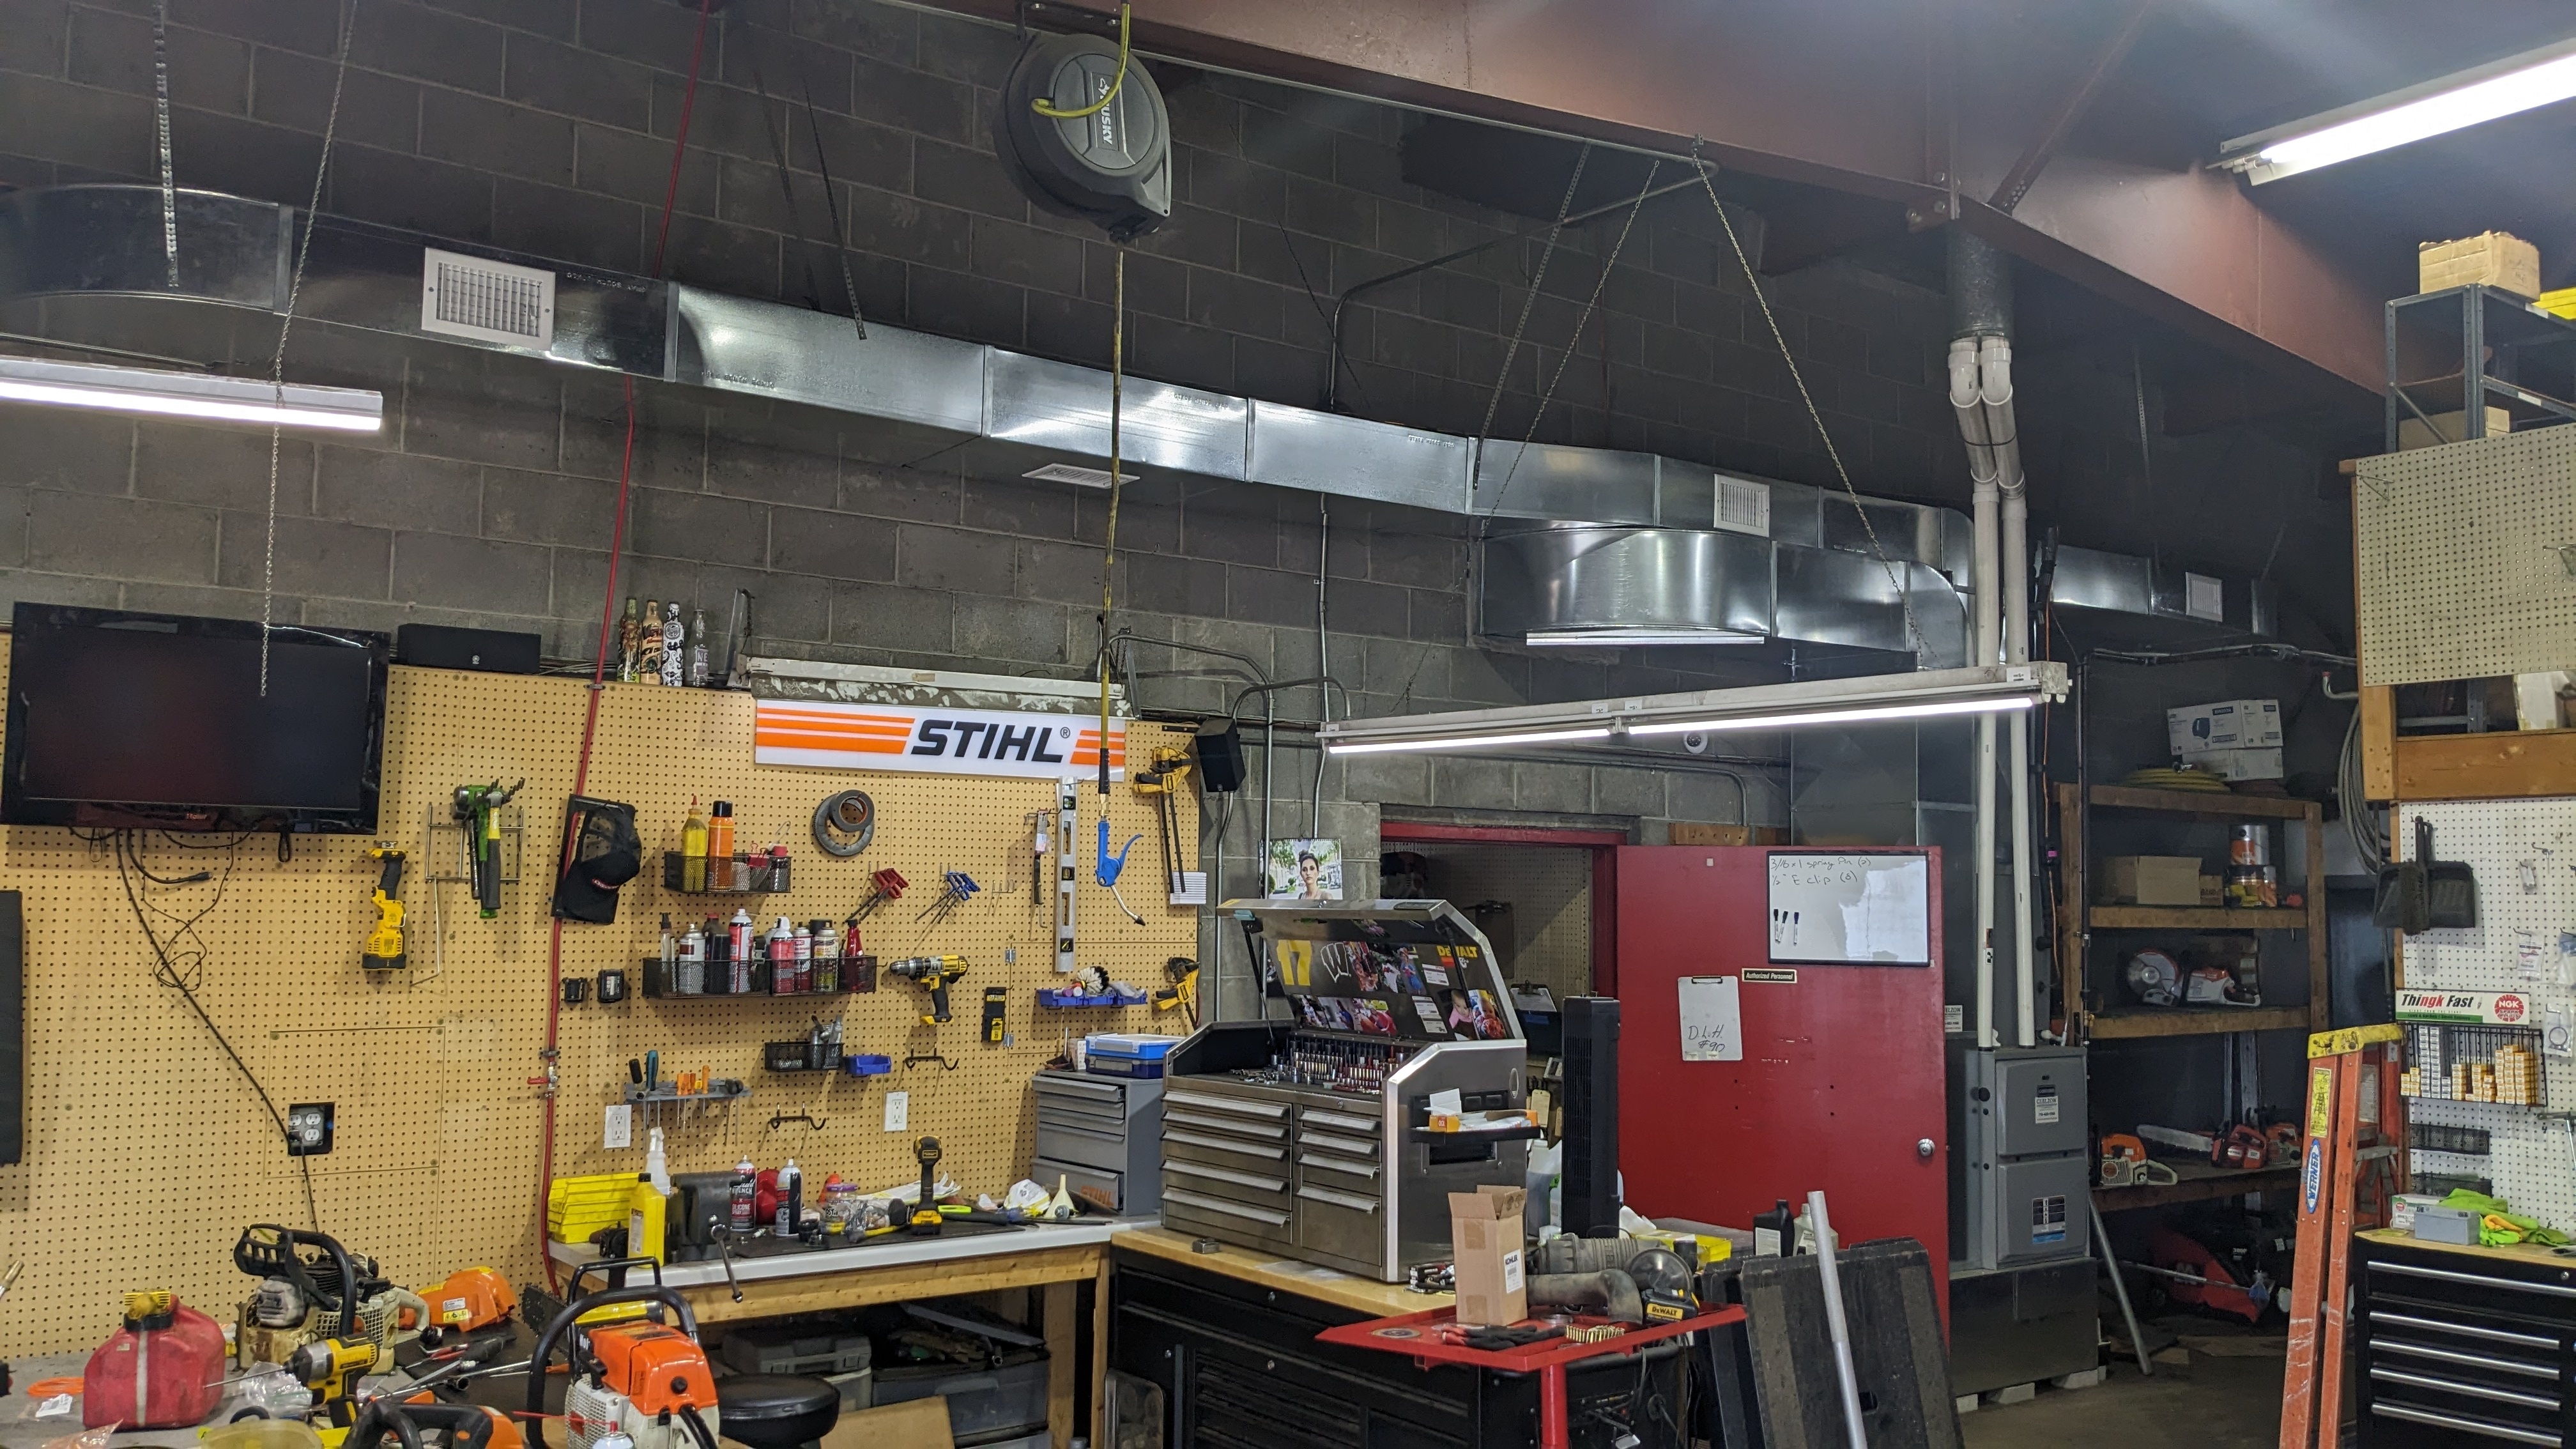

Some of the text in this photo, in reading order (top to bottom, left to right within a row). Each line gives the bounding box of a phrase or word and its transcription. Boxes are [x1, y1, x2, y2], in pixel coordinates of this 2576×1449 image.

[1101, 101, 1113, 146] USKY
[911, 719, 1064, 763] STIHL
[1791, 875, 1800, 885] E
[1807, 859, 1835, 870] spring
[1276, 940, 1312, 986] 17
[1320, 942, 1351, 983] W
[2401, 994, 2474, 1008] Thingk Fast
[1698, 1040, 1725, 1052] #90
[2308, 1152, 2319, 1200] WERNER
[1081, 1186, 1114, 1208] STIHL
